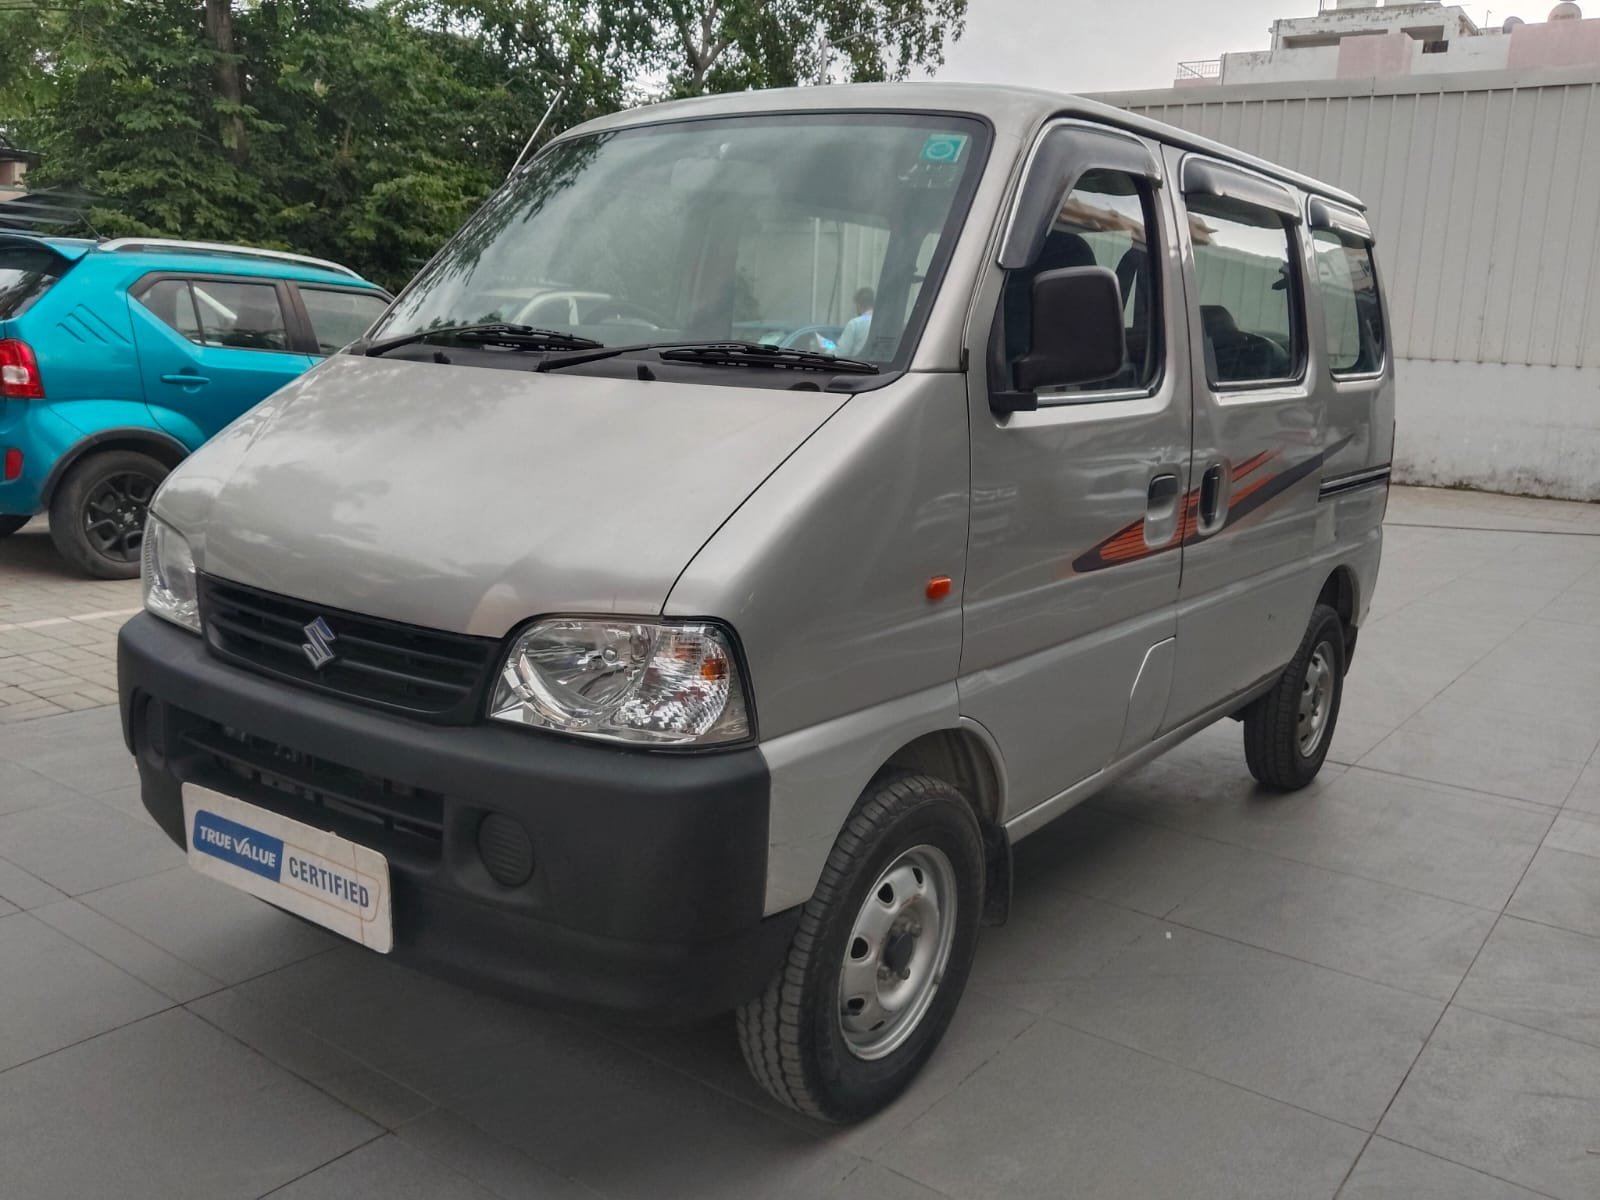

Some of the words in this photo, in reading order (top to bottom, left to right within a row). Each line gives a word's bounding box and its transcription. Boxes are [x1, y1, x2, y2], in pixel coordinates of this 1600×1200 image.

[200, 825, 232, 850] TRUE
[233, 837, 276, 868] VALUE
[289, 856, 369, 908] CERTIFIED
